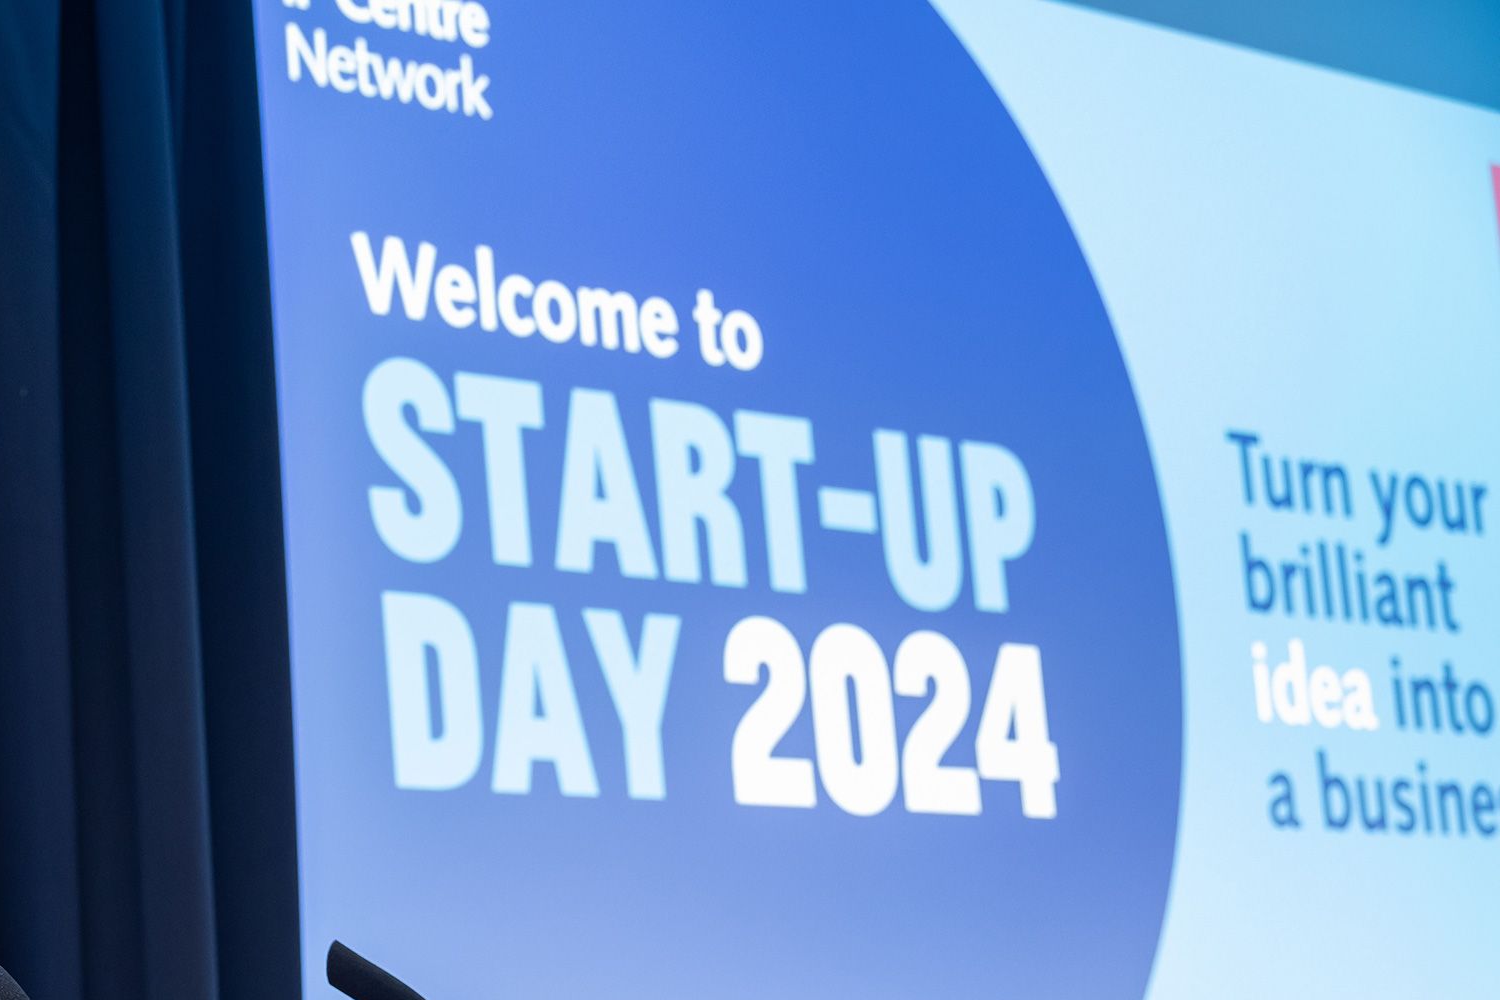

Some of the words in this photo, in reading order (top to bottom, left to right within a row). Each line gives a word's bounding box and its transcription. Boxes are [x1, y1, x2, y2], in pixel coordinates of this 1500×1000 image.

[285, 22, 493, 121] Network
[350, 231, 680, 359] Welcome
[693, 287, 764, 371] to
[362, 356, 1036, 613] START-UP
[1226, 429, 1353, 518] Turn
[1369, 468, 1489, 546] your
[1238, 530, 1461, 634] brilliant
[381, 590, 682, 800] DAY
[723, 615, 1060, 819] 2024
[1250, 638, 1380, 732] idea
[1390, 656, 1496, 735] into
[1267, 771, 1302, 830] a
[1316, 747, 1500, 837] busine
